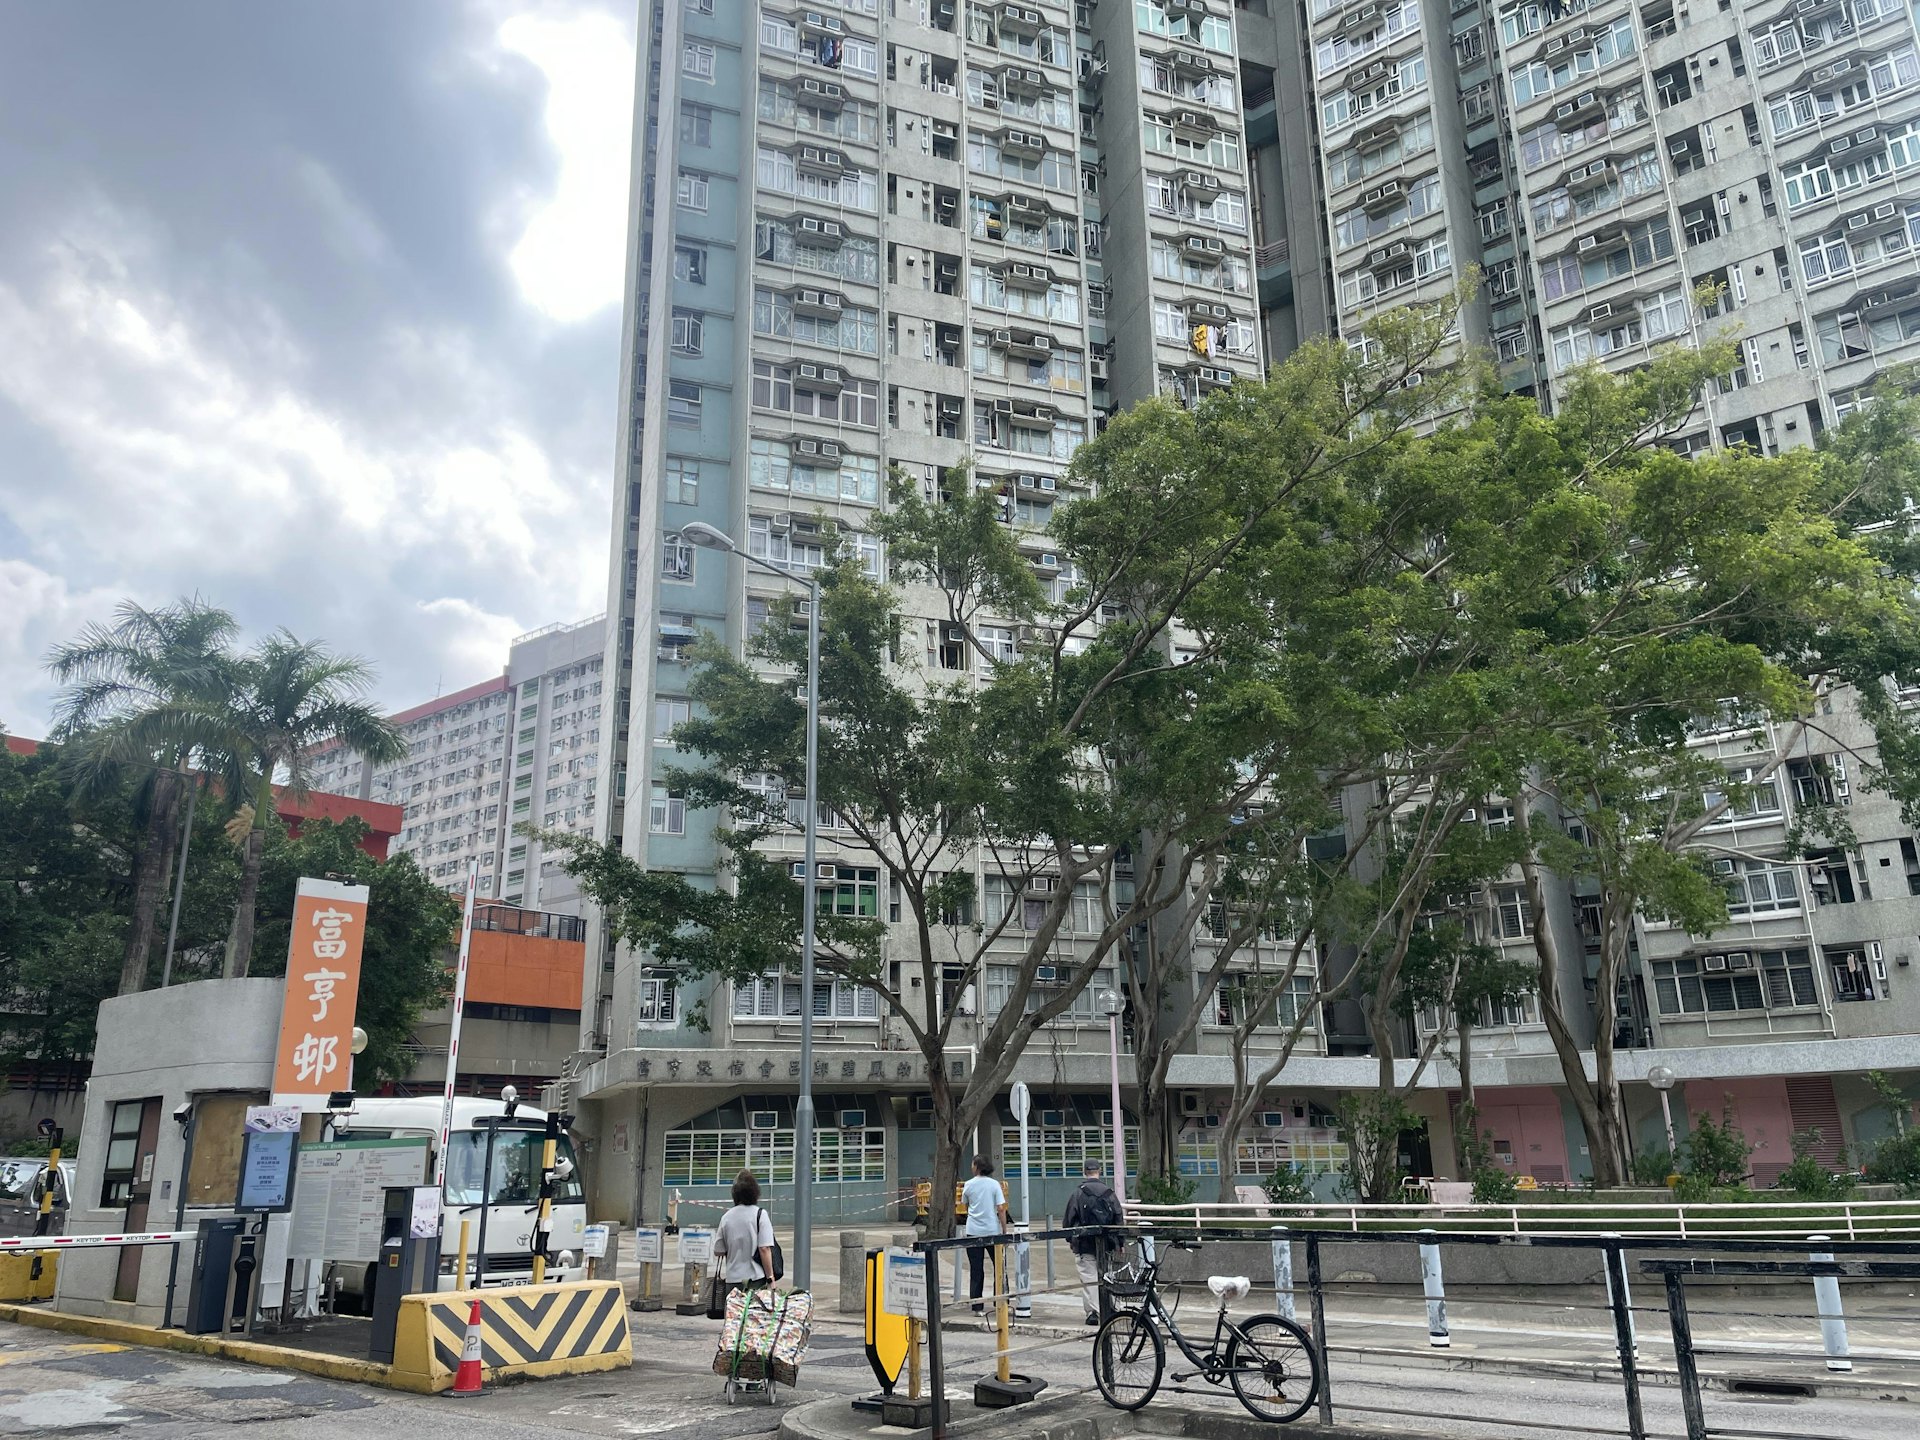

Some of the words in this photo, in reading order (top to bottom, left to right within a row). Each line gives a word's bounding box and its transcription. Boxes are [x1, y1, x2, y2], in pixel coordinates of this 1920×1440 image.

[292, 907, 353, 1086] 富亨邨
[637, 1057, 964, 1079] 富亨浸信會呂郭碧鳳幼園
